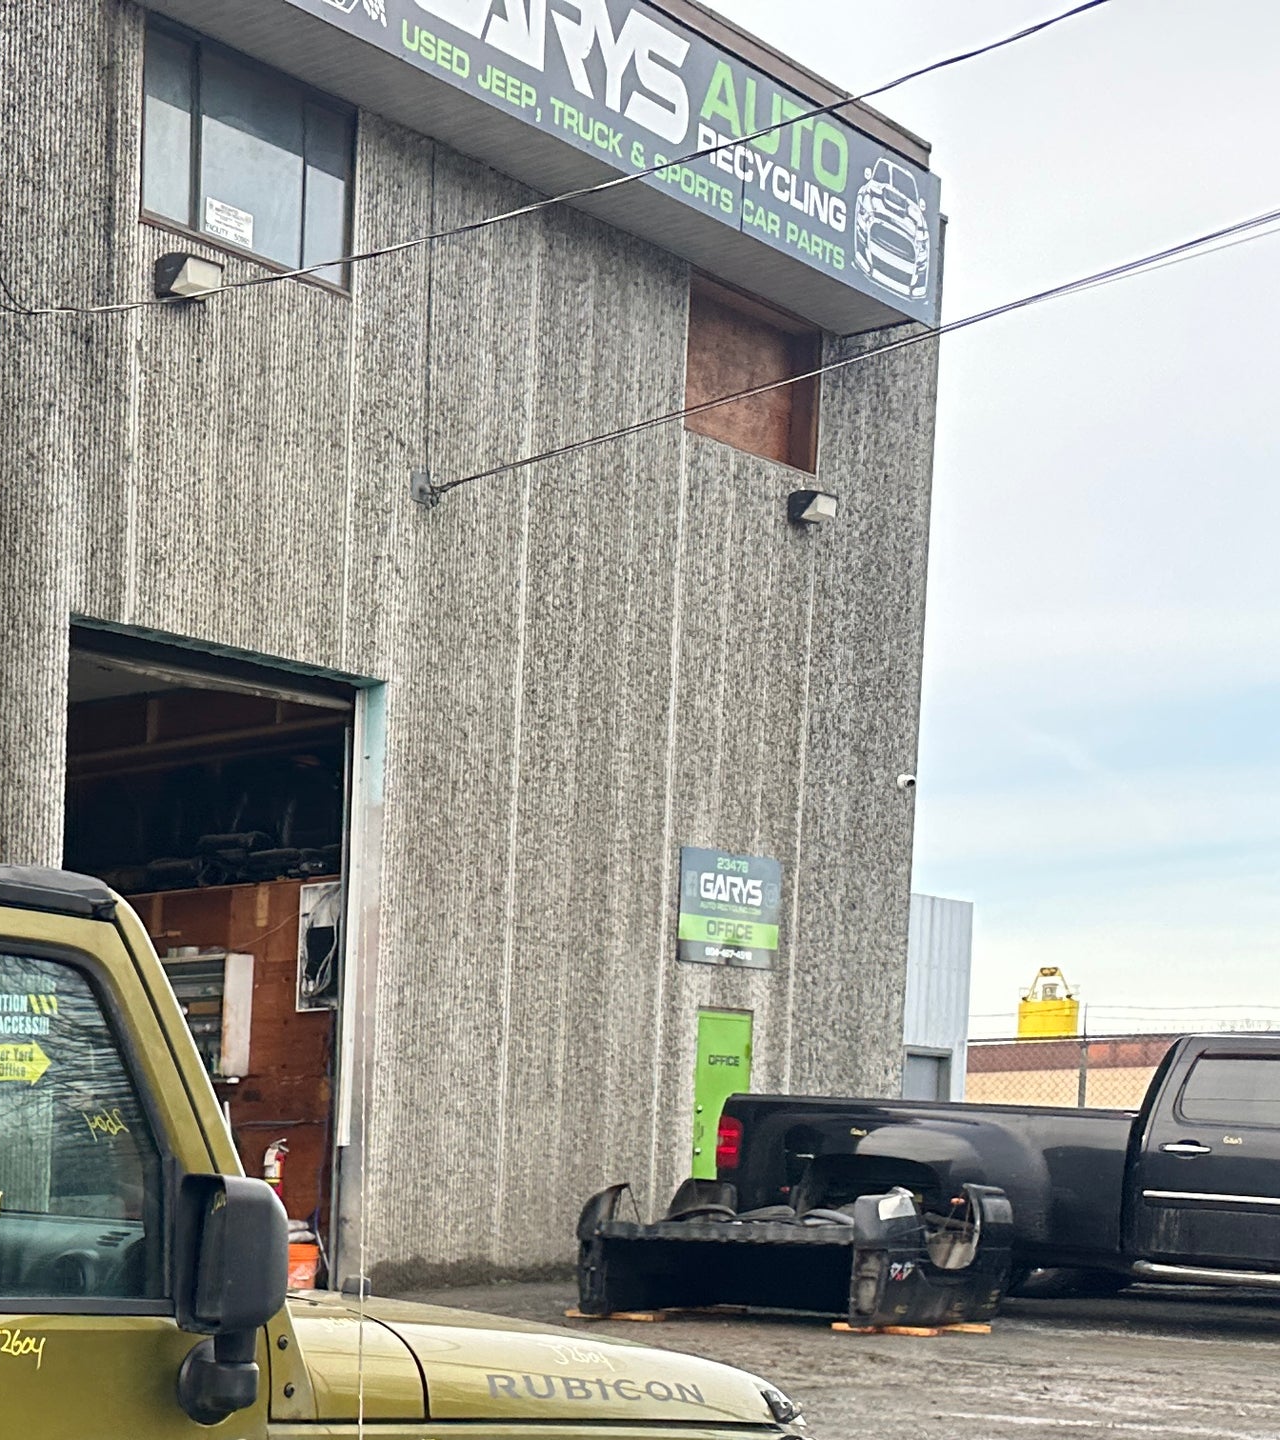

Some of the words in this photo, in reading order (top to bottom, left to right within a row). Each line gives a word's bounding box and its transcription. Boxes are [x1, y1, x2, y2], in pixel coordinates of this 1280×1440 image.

[414, 0, 692, 146] ARYS
[700, 60, 849, 193] AUTO
[401, 19, 470, 79] USED
[477, 63, 542, 122] JEEP,
[549, 97, 623, 152] TRUCK
[630, 140, 646, 170] &
[653, 153, 734, 214] SPORTS
[742, 198, 780, 243] CAR
[786, 221, 846, 271] PARTS
[698, 122, 847, 233] RECYCLING
[700, 872, 763, 906] GARYS
[706, 920, 753, 941] OFFICE
[486, 1373, 706, 1405] RUBICON
